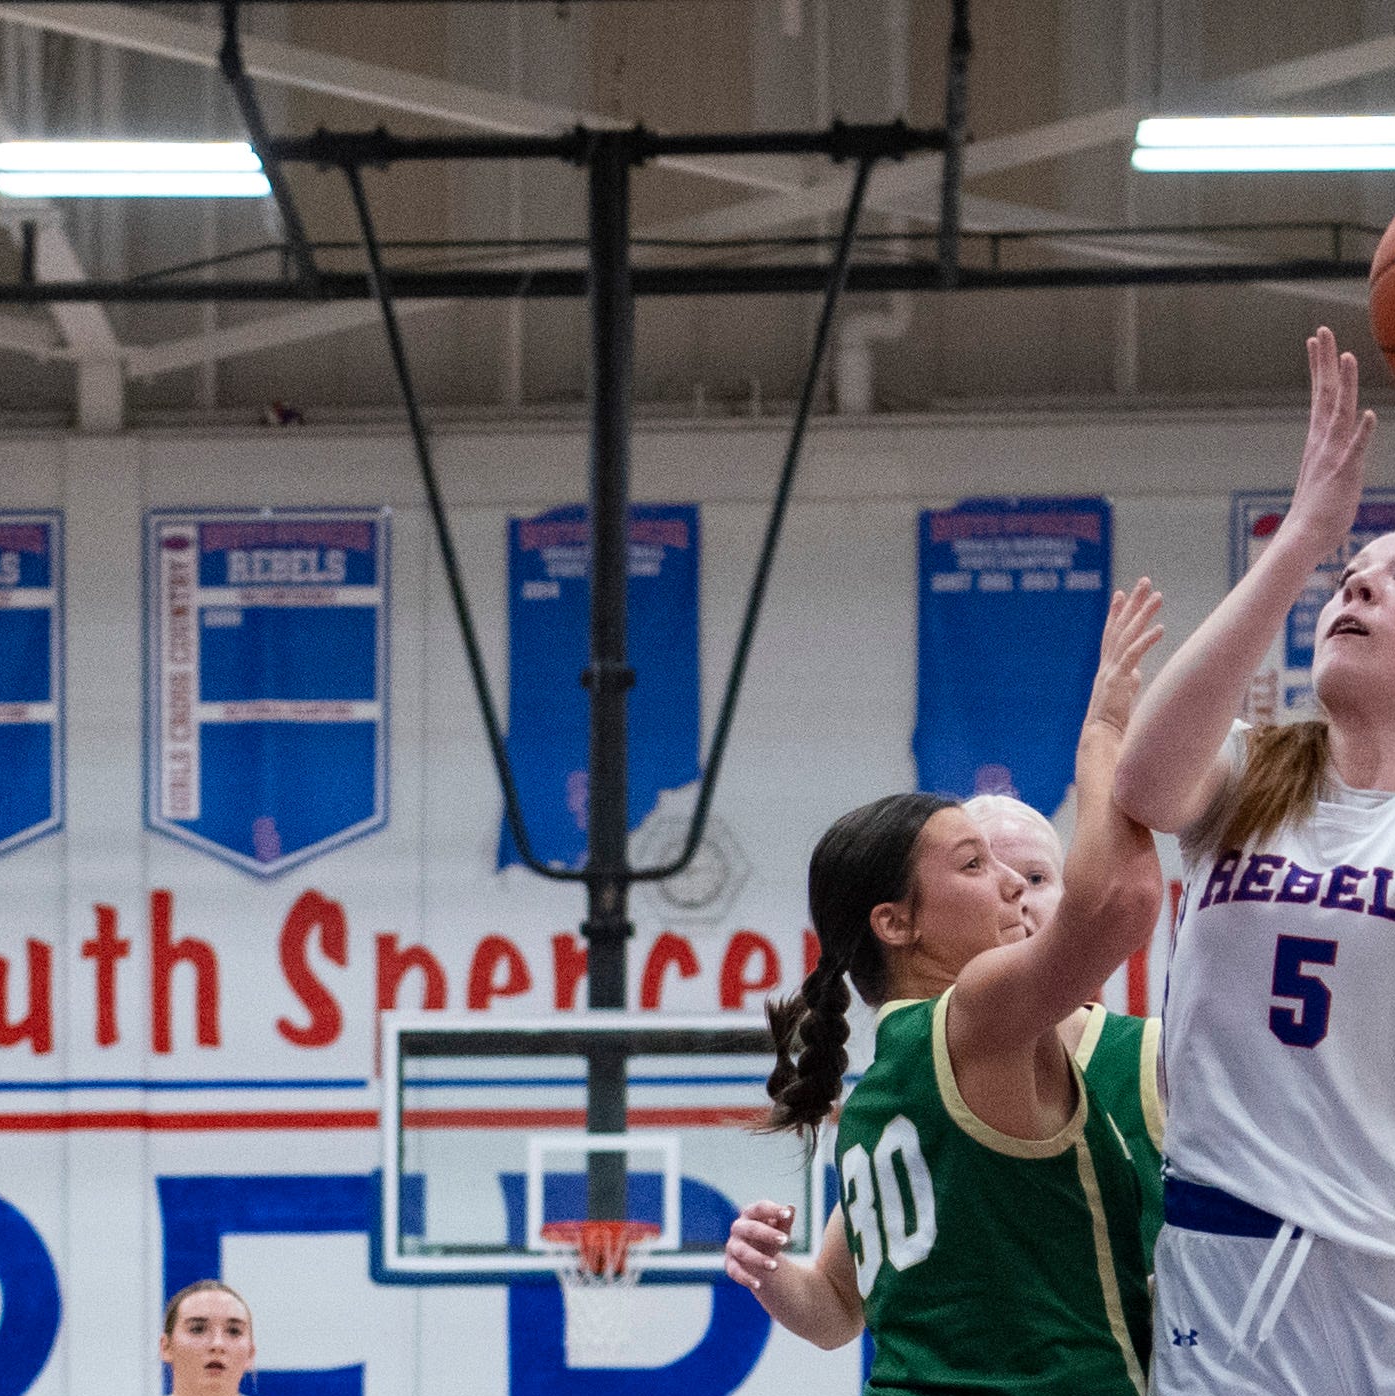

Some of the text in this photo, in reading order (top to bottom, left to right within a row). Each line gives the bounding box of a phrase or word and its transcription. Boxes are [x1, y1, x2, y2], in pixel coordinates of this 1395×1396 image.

[227, 549, 346, 583] REBELS
[1268, 933, 1340, 1050] 5
[841, 1113, 938, 1299] 30
